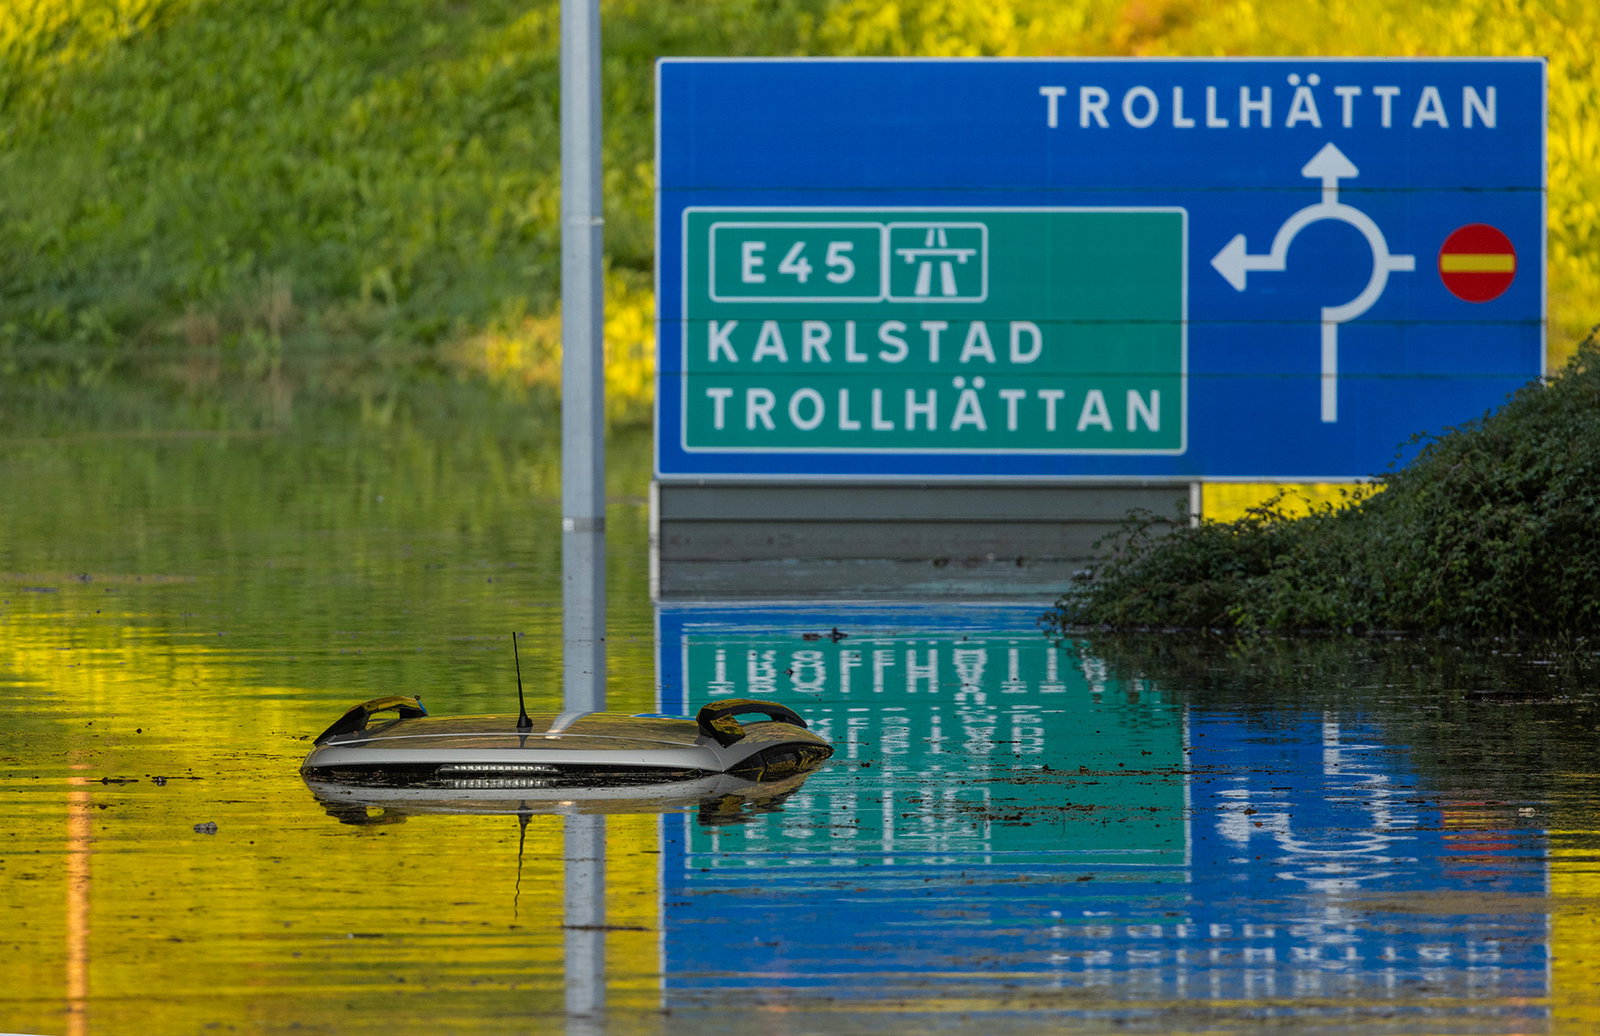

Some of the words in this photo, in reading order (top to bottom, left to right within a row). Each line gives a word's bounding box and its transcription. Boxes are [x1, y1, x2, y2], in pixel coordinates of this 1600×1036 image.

[1040, 74, 1497, 128] TROLLHÄTTAN
[708, 319, 1043, 363] KARLSTAD
[706, 377, 1162, 432] TROLLHÄTTAN
